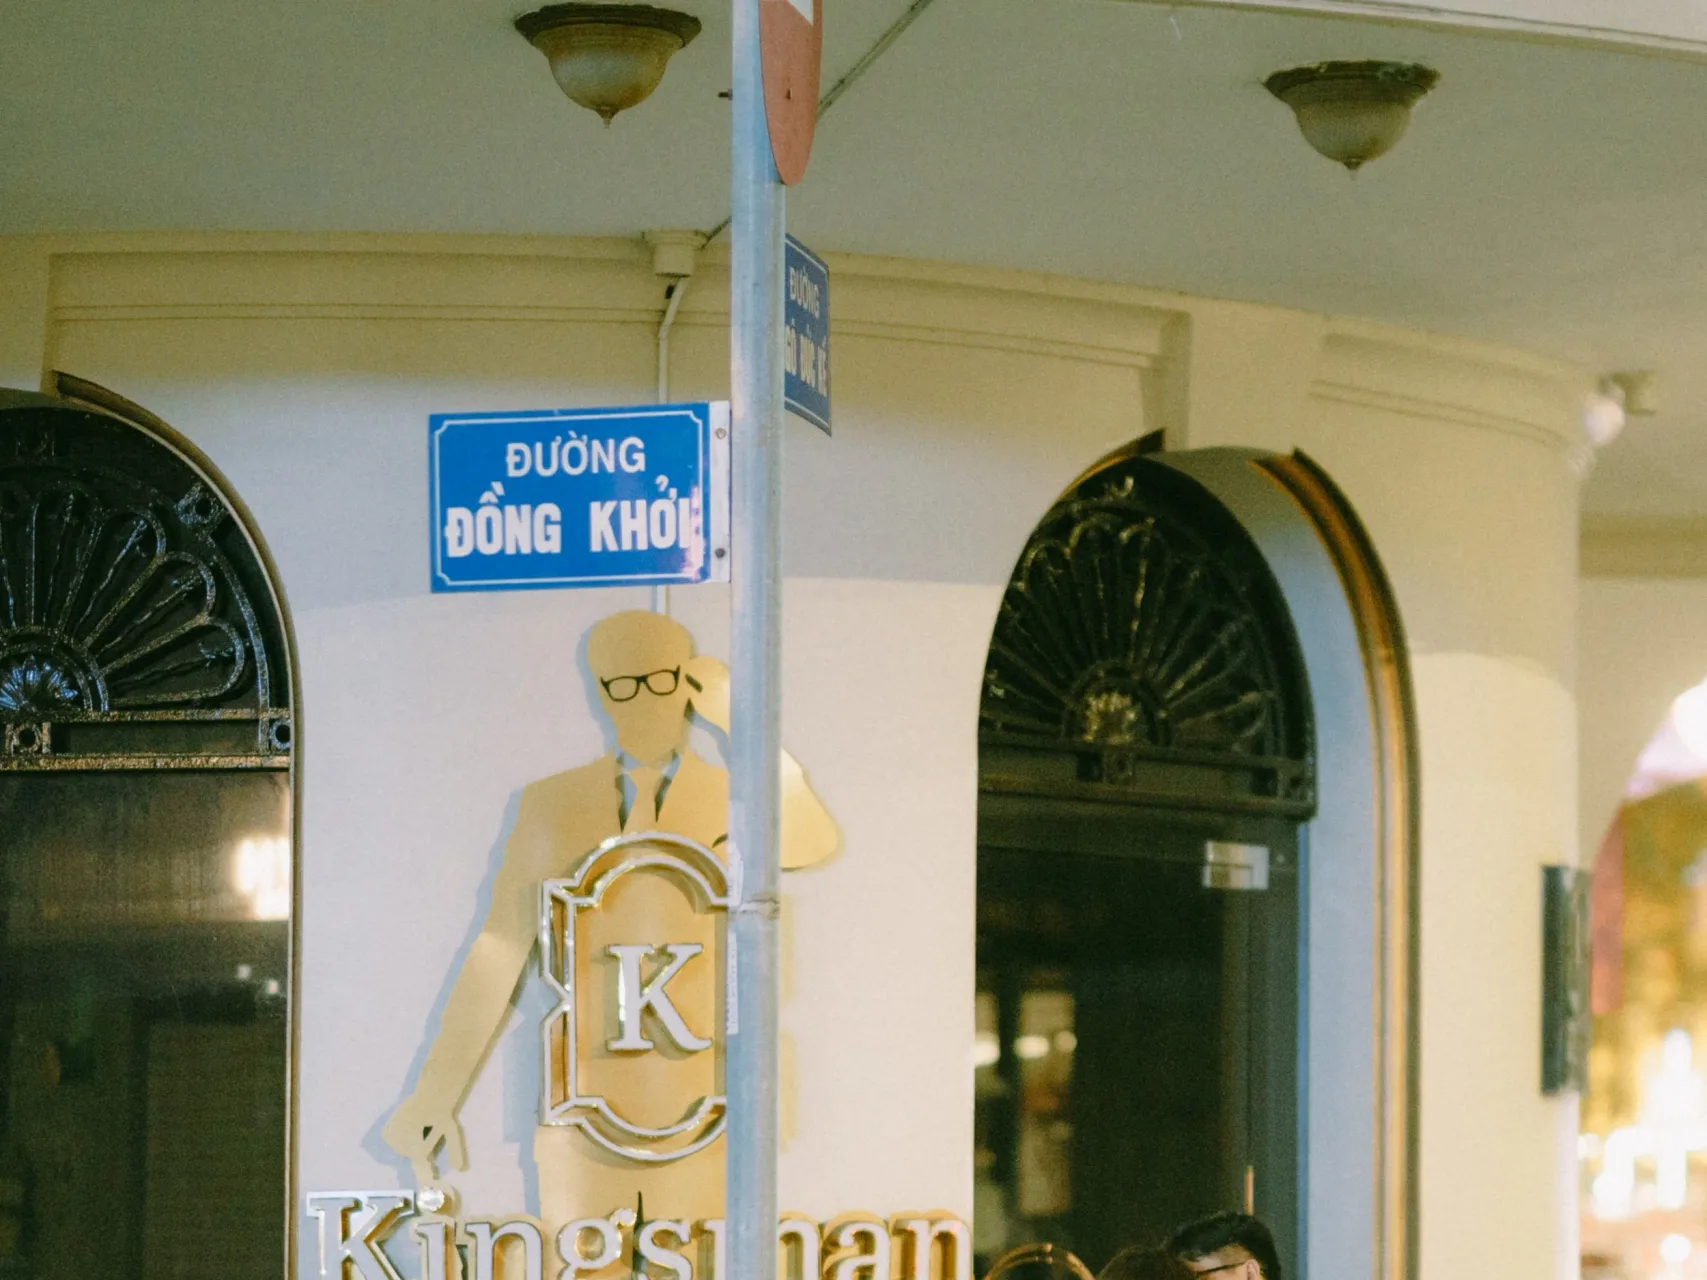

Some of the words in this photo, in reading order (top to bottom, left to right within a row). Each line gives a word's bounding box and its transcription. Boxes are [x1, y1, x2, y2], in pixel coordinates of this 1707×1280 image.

[505, 430, 647, 478] ĐƯỜNG
[444, 480, 562, 558] ĐỒNG
[589, 474, 694, 553] KHỞI
[605, 943, 713, 1051] K
